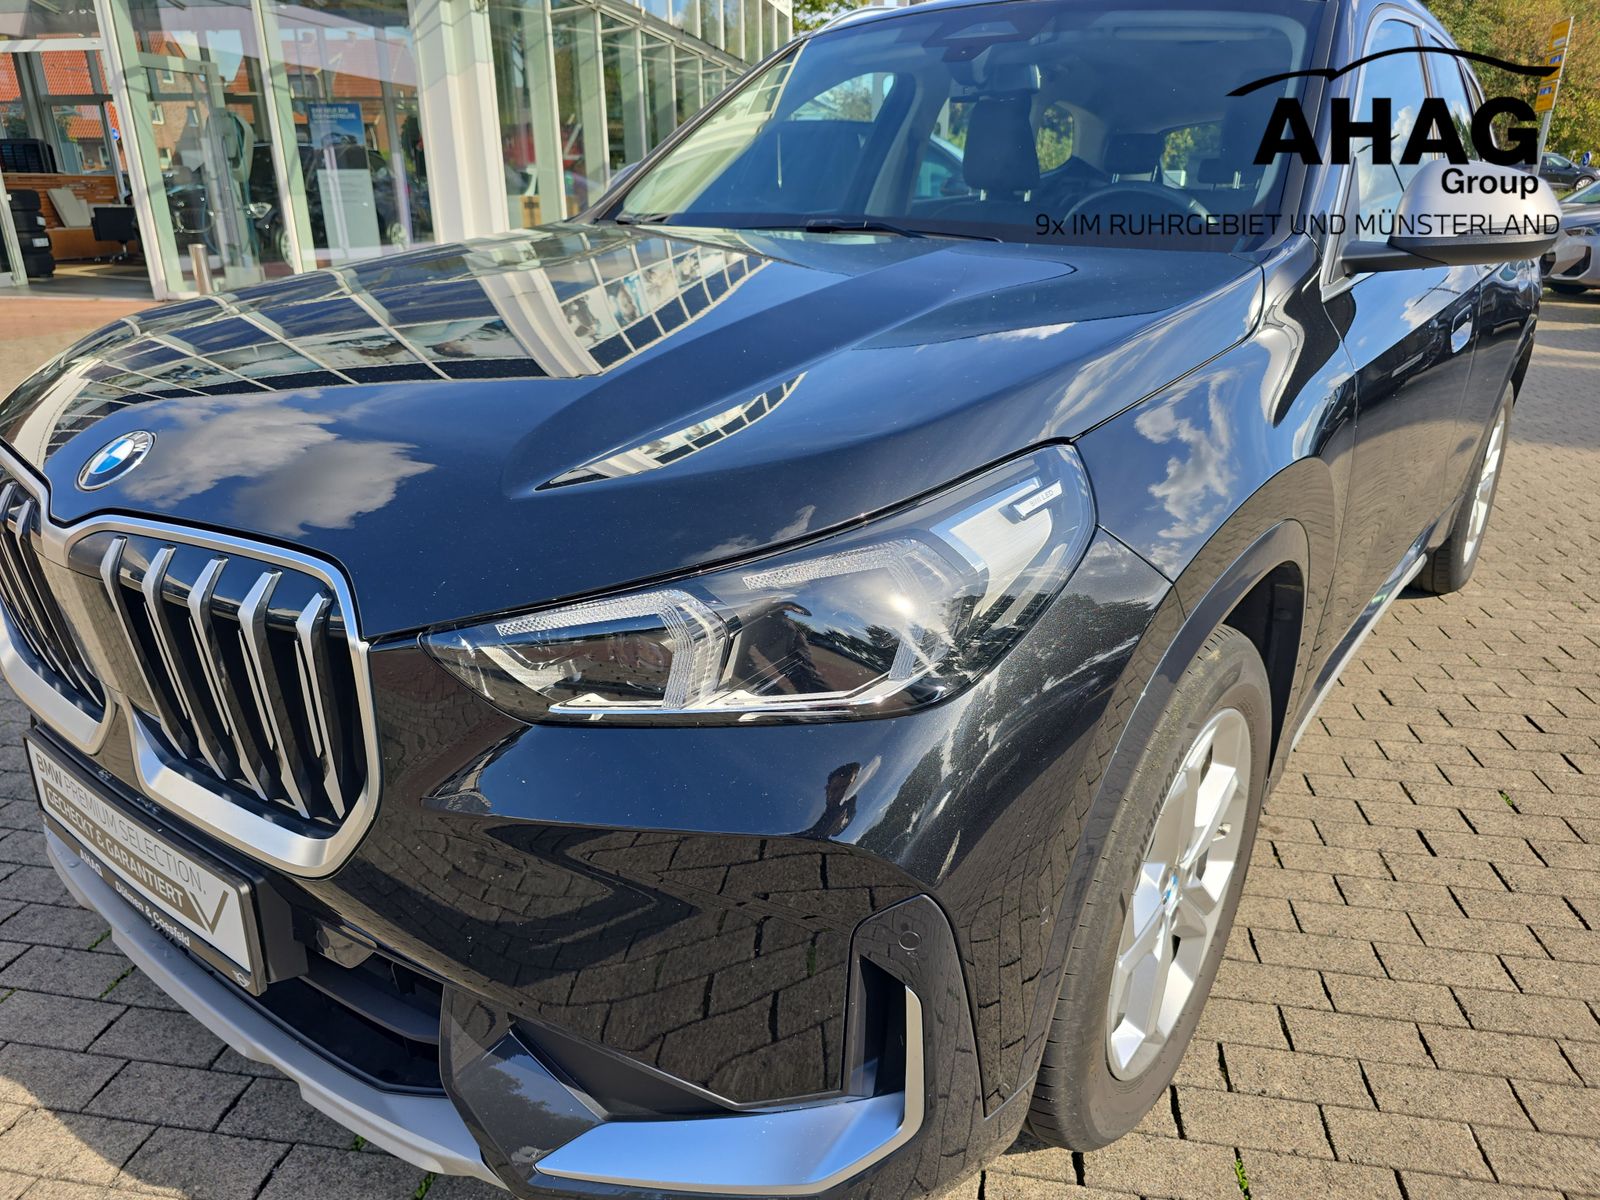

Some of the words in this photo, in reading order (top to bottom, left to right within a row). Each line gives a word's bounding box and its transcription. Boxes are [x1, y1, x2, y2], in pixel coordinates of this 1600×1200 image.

[36, 752, 63, 788] BMW
[64, 775, 118, 834] PREMIUM
[46, 786, 94, 840] GECHECKT
[95, 829, 106, 849] &
[105, 837, 184, 908] GARANTIERT
[79, 848, 104, 878] AHAG
[152, 911, 191, 947] Coesfeld
